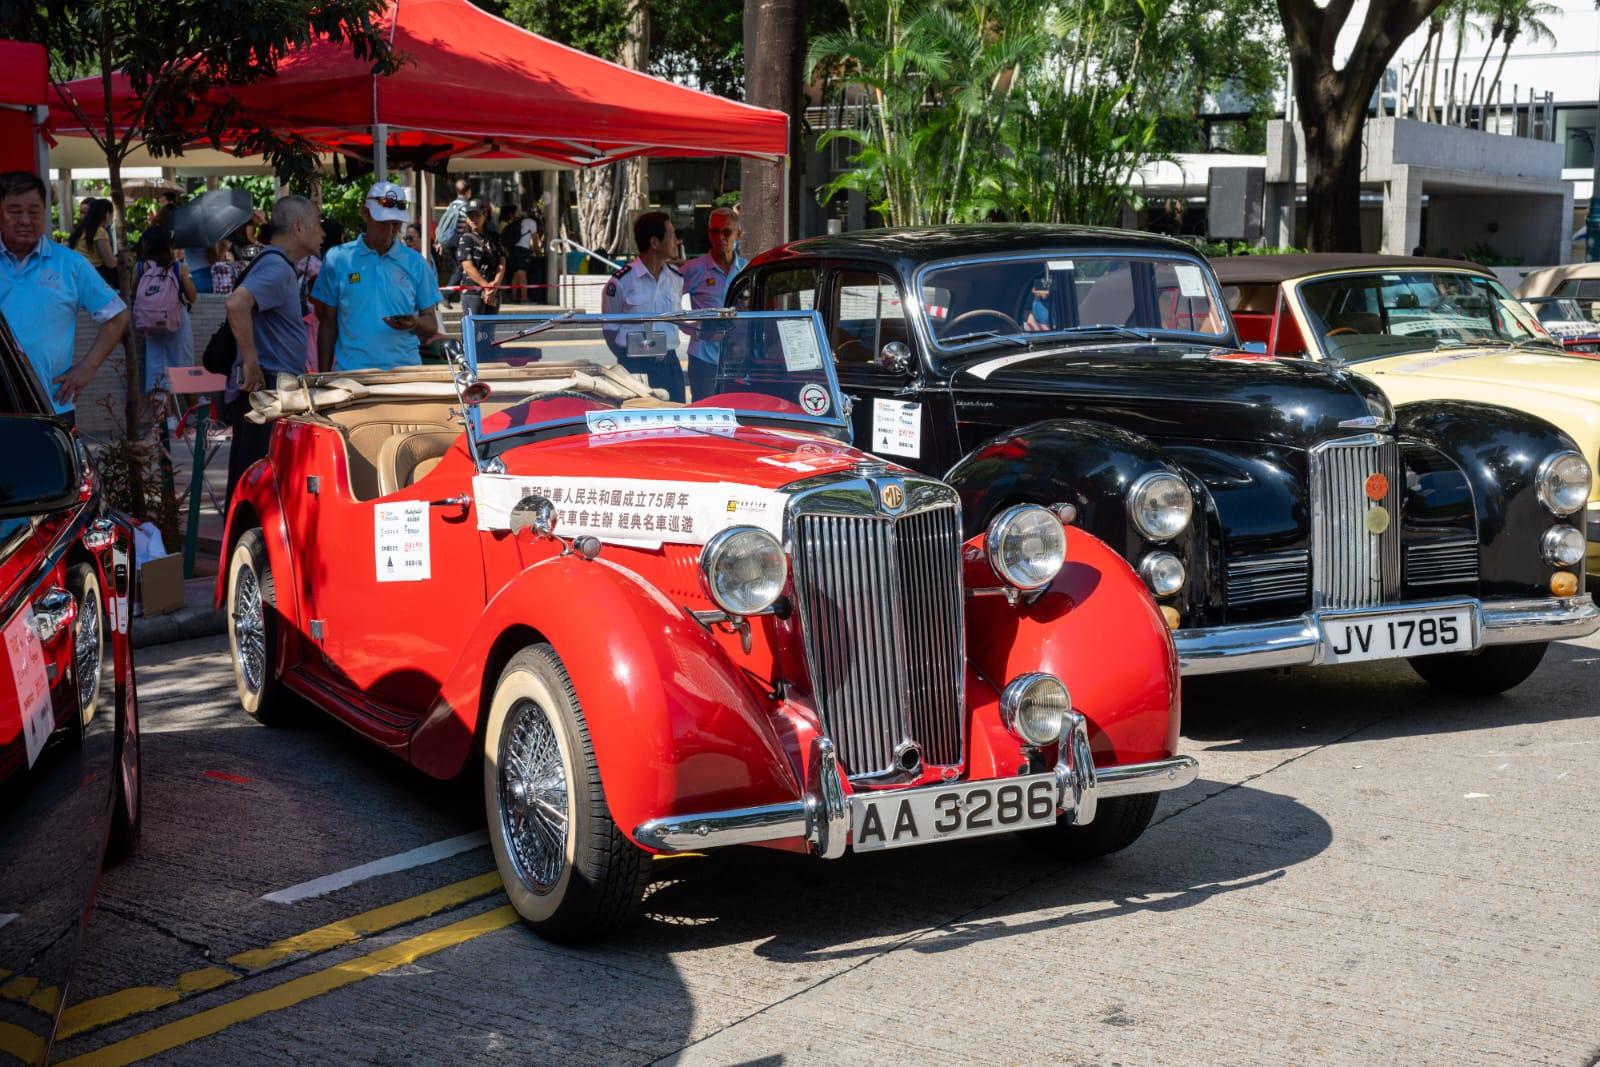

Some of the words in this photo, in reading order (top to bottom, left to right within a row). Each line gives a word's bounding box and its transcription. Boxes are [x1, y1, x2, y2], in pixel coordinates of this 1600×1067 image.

[885, 487, 903, 507] MG
[618, 513, 693, 533] 經典名車巡遊
[1333, 624, 1373, 655] JV
[1388, 616, 1458, 650] 1785
[859, 799, 918, 843] AA
[934, 781, 1051, 833] 3286
